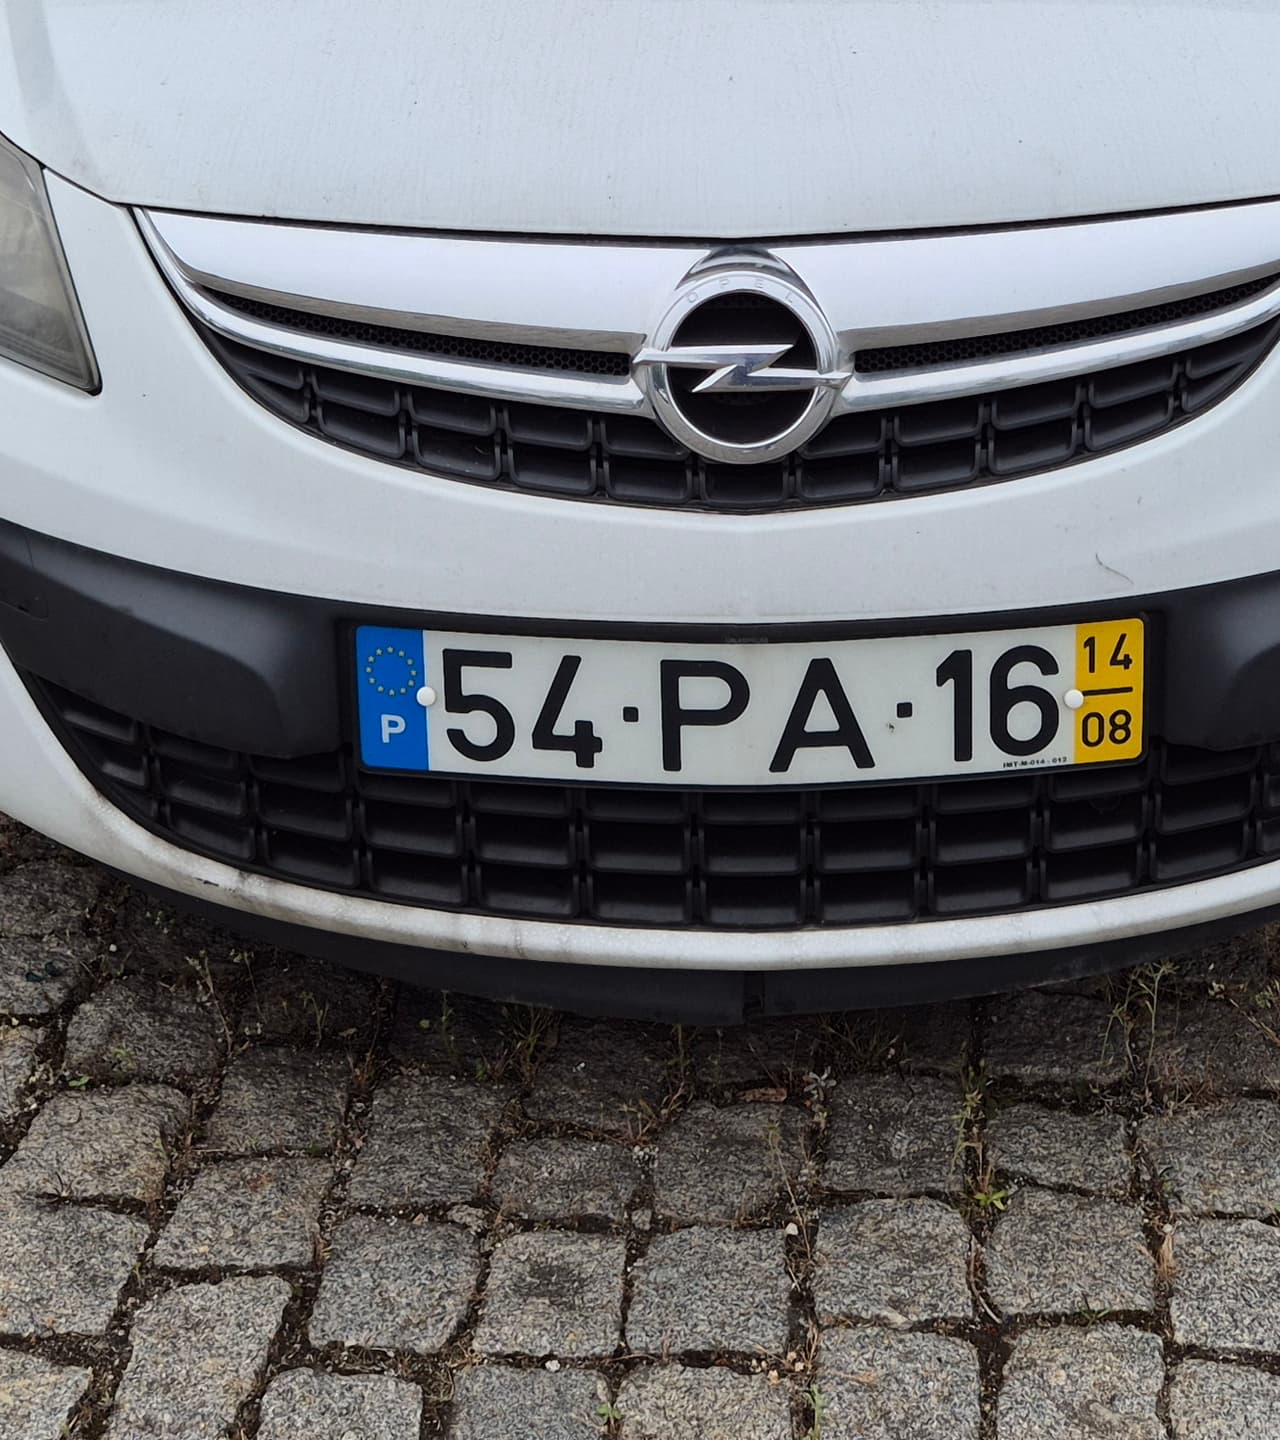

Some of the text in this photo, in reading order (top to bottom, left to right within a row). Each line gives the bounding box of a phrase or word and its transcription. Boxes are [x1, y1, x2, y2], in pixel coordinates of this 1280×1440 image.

[687, 279, 793, 304] OPEL
[1083, 632, 1133, 674] 14
[380, 713, 406, 744] P
[1082, 709, 1132, 748] 08
